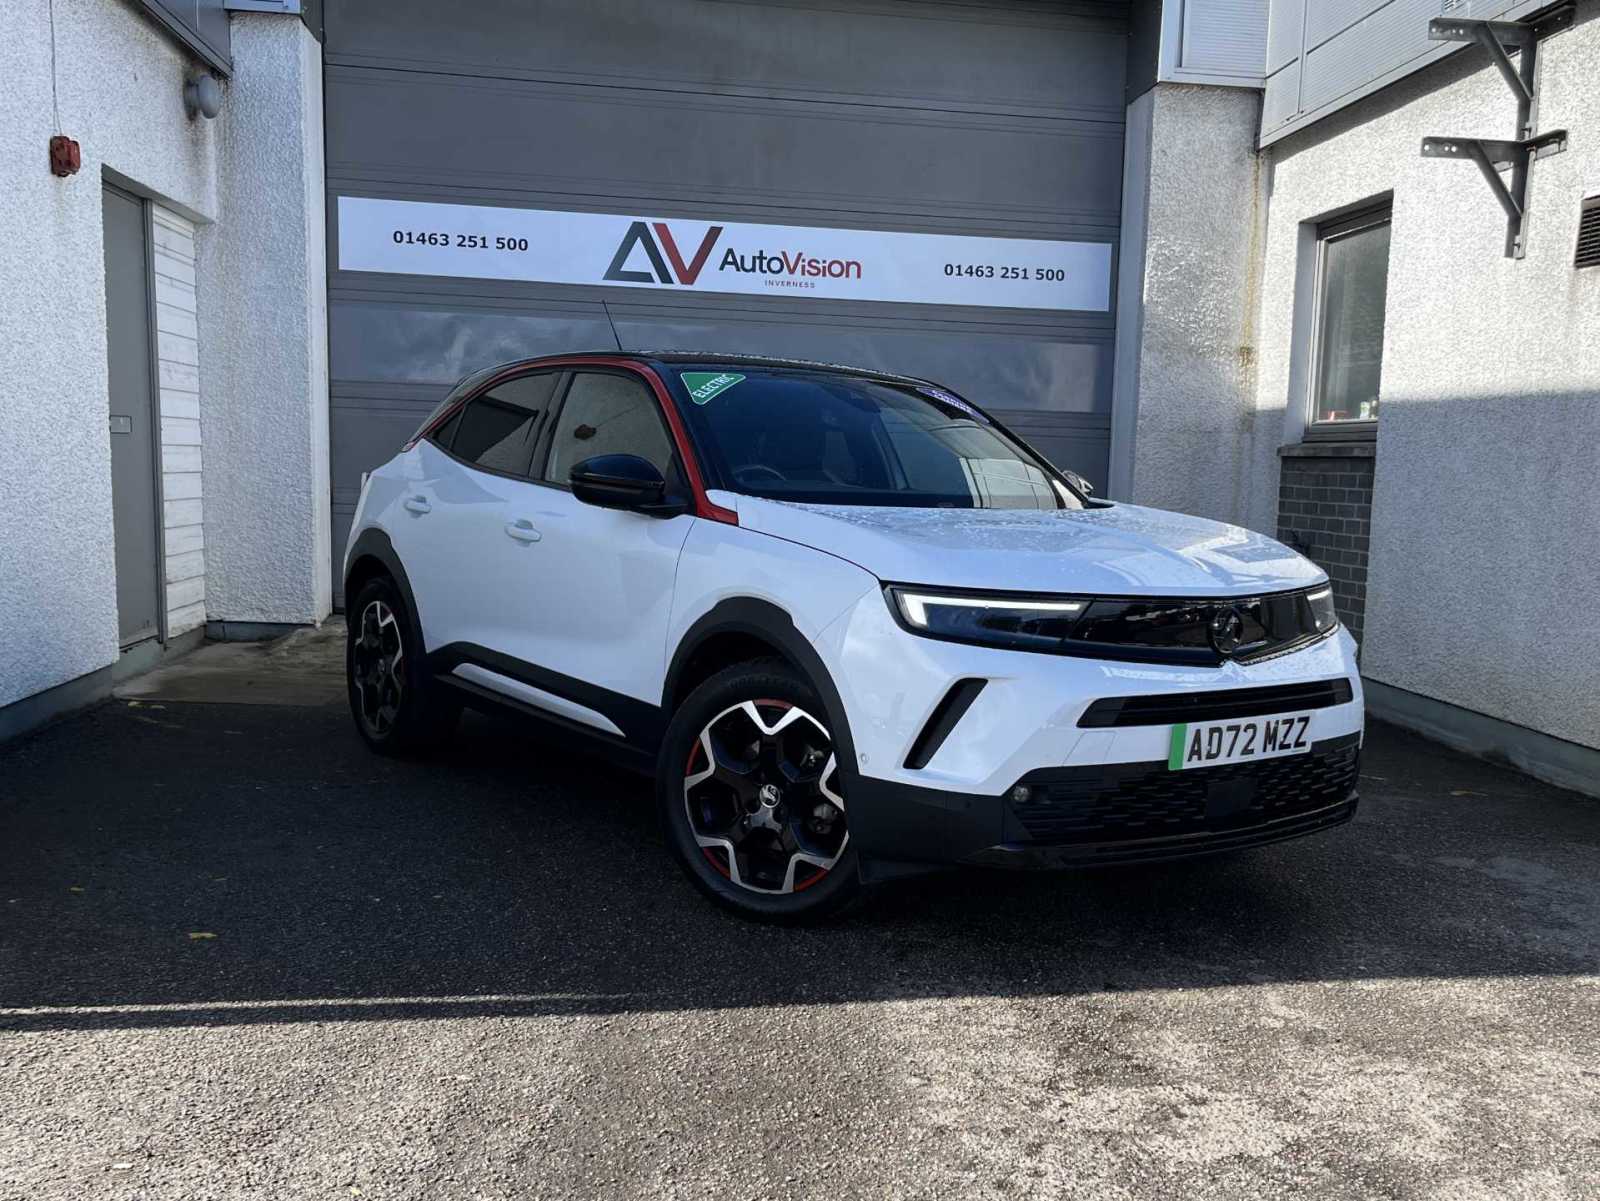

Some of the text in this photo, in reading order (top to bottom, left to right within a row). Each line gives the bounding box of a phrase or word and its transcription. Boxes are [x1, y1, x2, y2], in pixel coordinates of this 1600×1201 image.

[393, 230, 529, 251] 01463 251 500
[719, 247, 862, 279] AutoVision
[944, 263, 1065, 282] 01463 251 500
[764, 279, 816, 288] INVERNESS
[693, 374, 734, 398] ELECTRIC
[1187, 716, 1310, 762] AD72 MZZ
